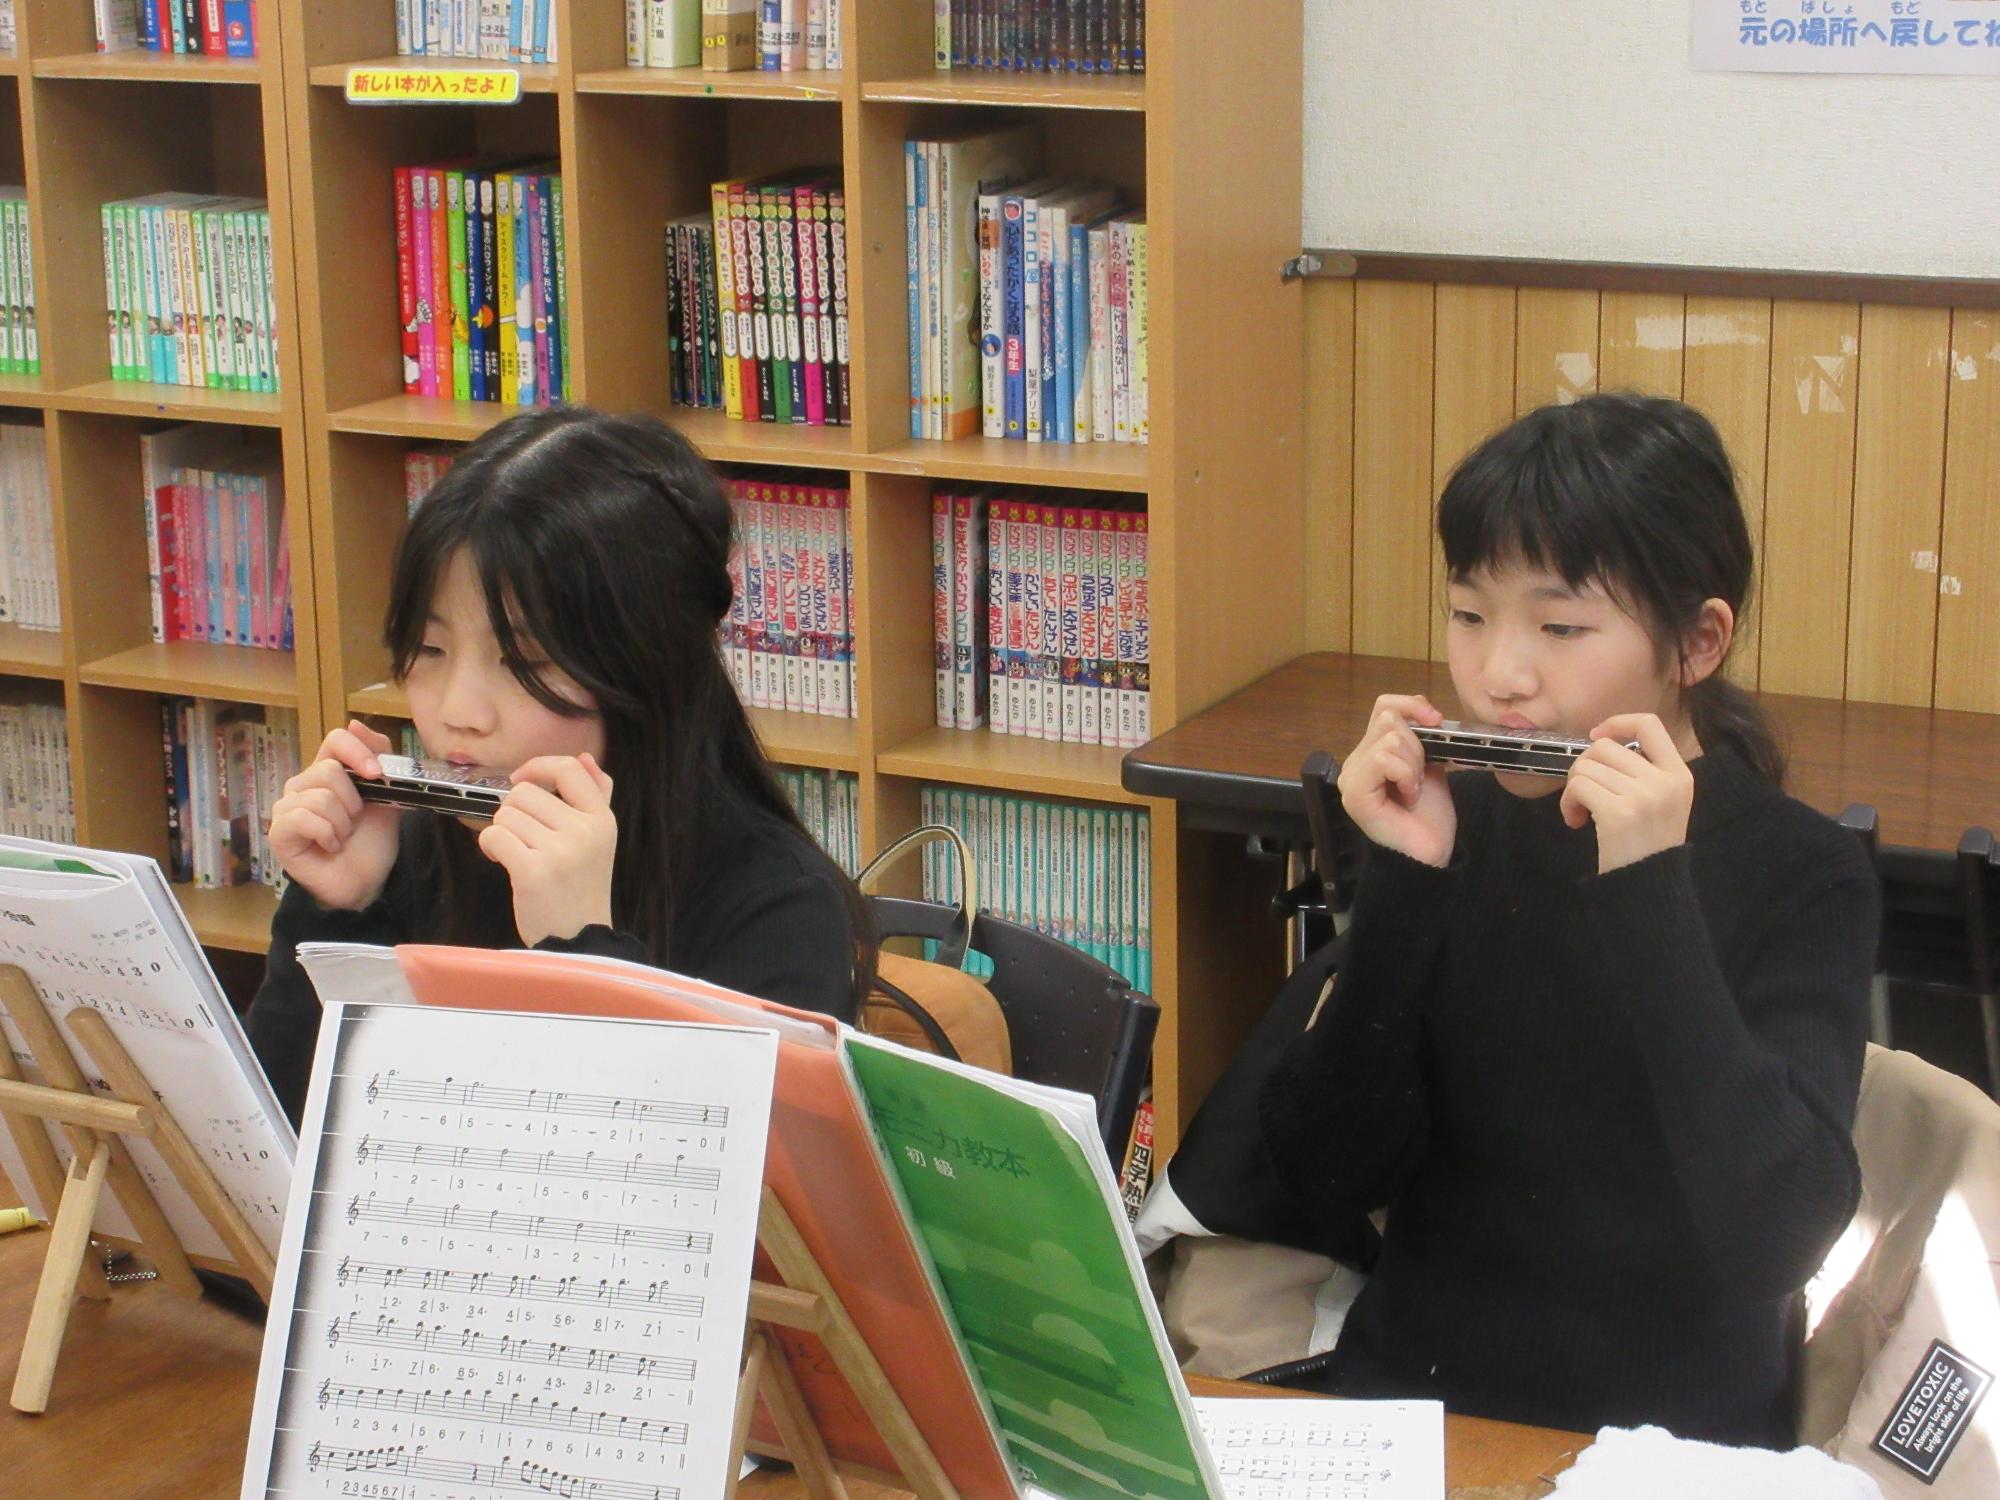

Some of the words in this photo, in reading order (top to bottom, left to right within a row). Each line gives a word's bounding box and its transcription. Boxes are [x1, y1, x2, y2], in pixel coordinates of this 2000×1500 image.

[1740, 0, 1767, 13] もと
[1892, 1, 1920, 15] もと
[354, 74, 507, 93] 新しい本が入ったよ！
[151, 961, 161, 972] 0
[1891, 1361, 1949, 1446] LOVETOXIC
[1913, 1419, 1935, 1452] Always
[1930, 1400, 1947, 1422] look
[1944, 1390, 1954, 1403] on
[1950, 1376, 1963, 1392] the
[1924, 1427, 1944, 1453] bright
[1940, 1410, 1955, 1429] side
[1959, 1387, 1971, 1402] life
